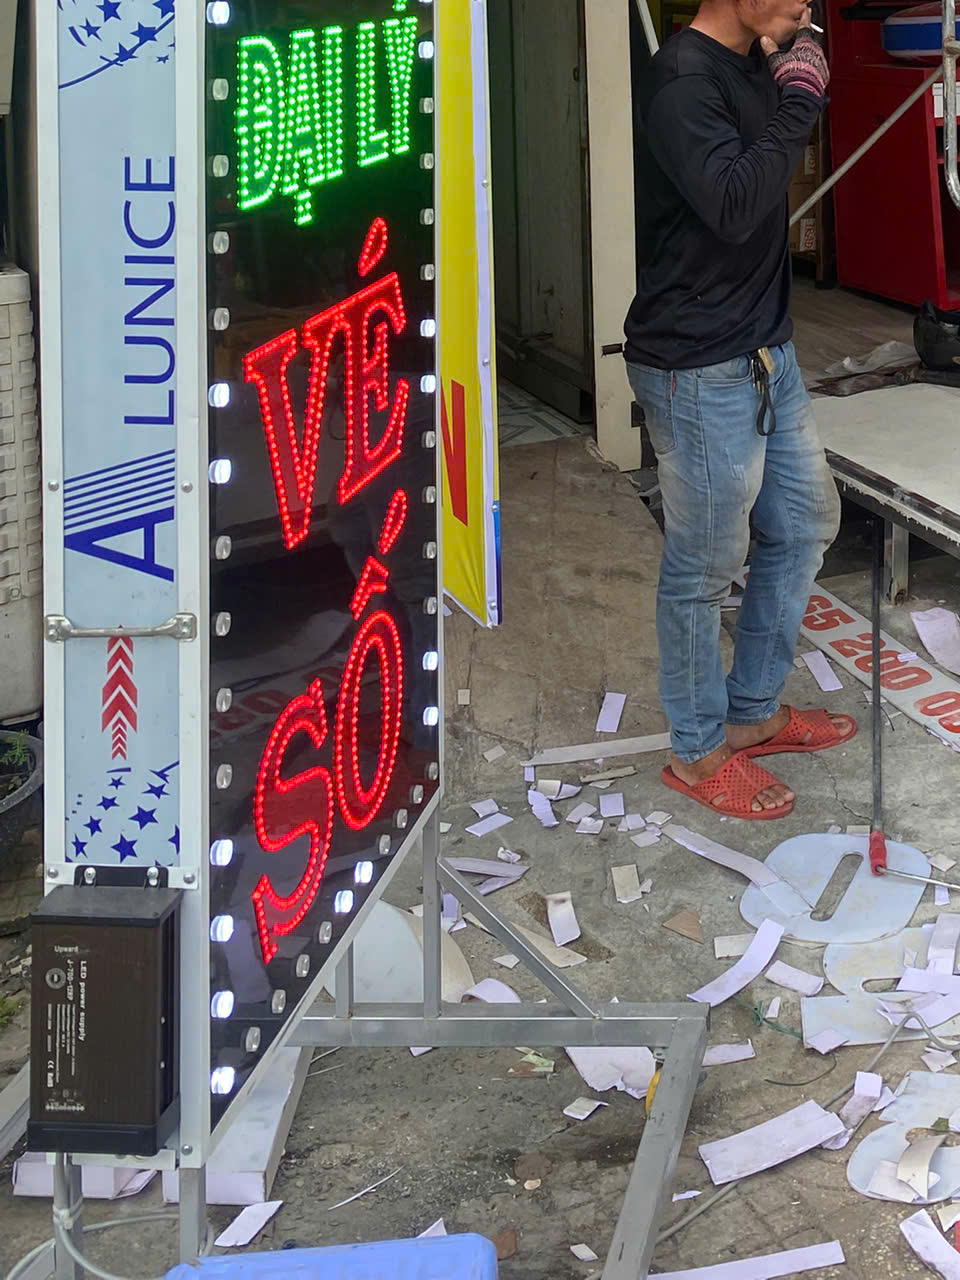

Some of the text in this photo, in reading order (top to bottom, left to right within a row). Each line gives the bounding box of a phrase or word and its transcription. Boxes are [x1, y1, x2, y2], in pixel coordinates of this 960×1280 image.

[234, 24, 344, 225] ĐẠI
[241, 216, 410, 551] VÉ
[252, 488, 409, 964] SỐ
[78, 1011, 87, 1042] supply
[80, 960, 88, 979] LED
